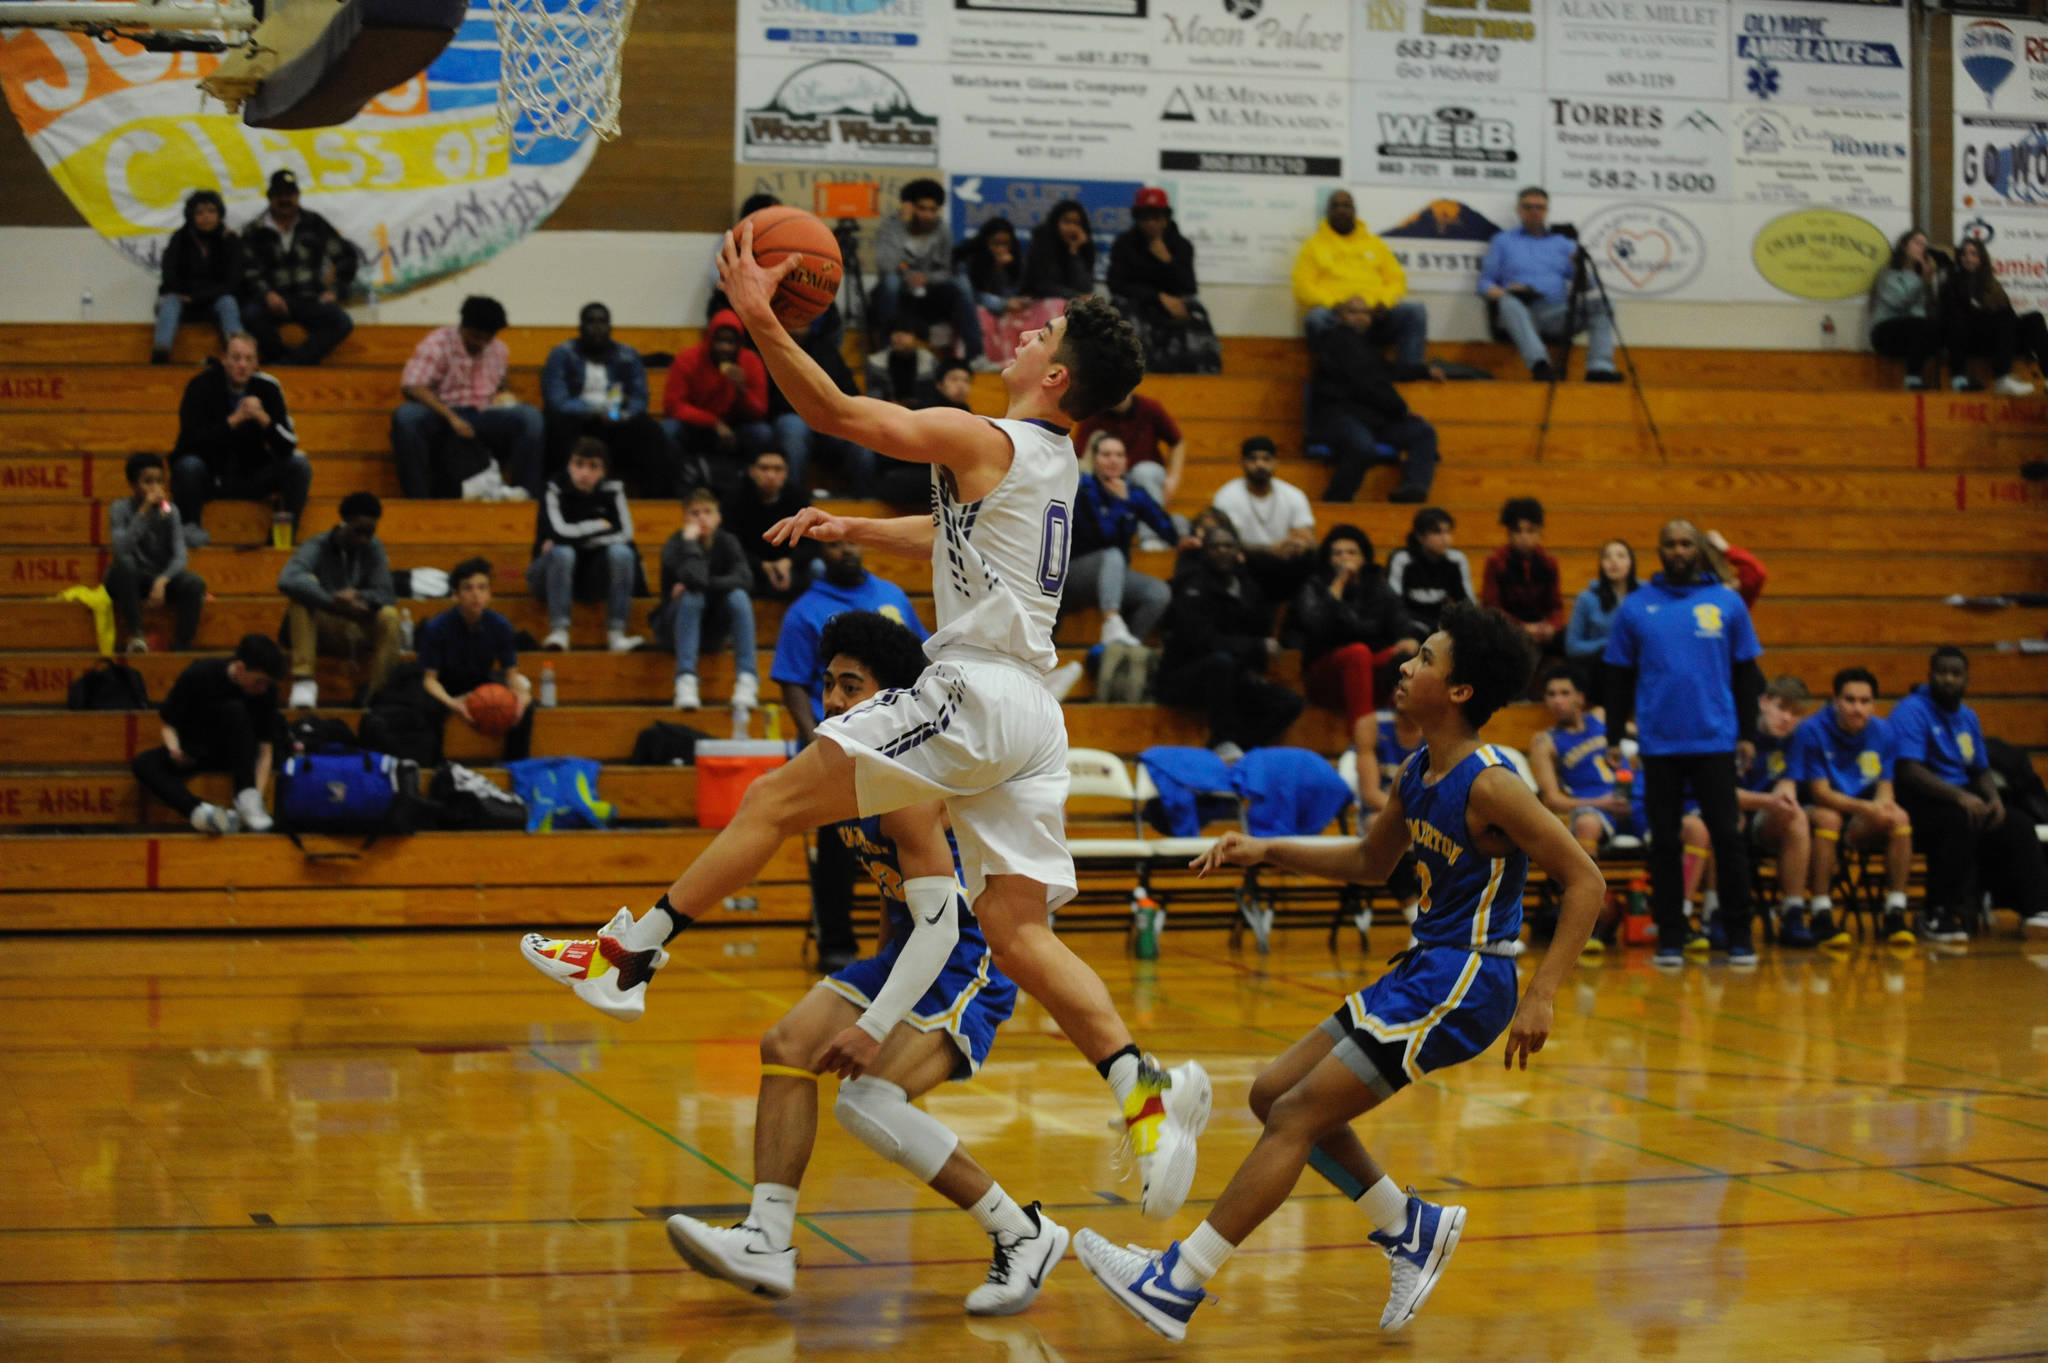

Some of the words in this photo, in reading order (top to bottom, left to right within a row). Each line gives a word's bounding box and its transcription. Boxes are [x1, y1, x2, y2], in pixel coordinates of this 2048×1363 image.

[1161, 12, 1245, 46] Moon
[1254, 12, 1343, 52] Palace
[1422, 8, 1536, 41] Insurance
[1396, 39, 1501, 63] 683-4970
[1549, 98, 1664, 130] TORRES
[751, 117, 831, 142] Wood
[838, 120, 932, 145] Works
[1377, 112, 1516, 154] WEBB
[104, 120, 404, 229] CLASS
[433, 131, 509, 180] OF
[1588, 168, 1717, 194] 582-1500
[0, 376, 64, 400] AISLE
[2, 464, 69, 489] AISLE
[1036, 498, 1070, 597] 0
[12, 558, 81, 582] AISLE
[37, 788, 116, 814] AISLE
